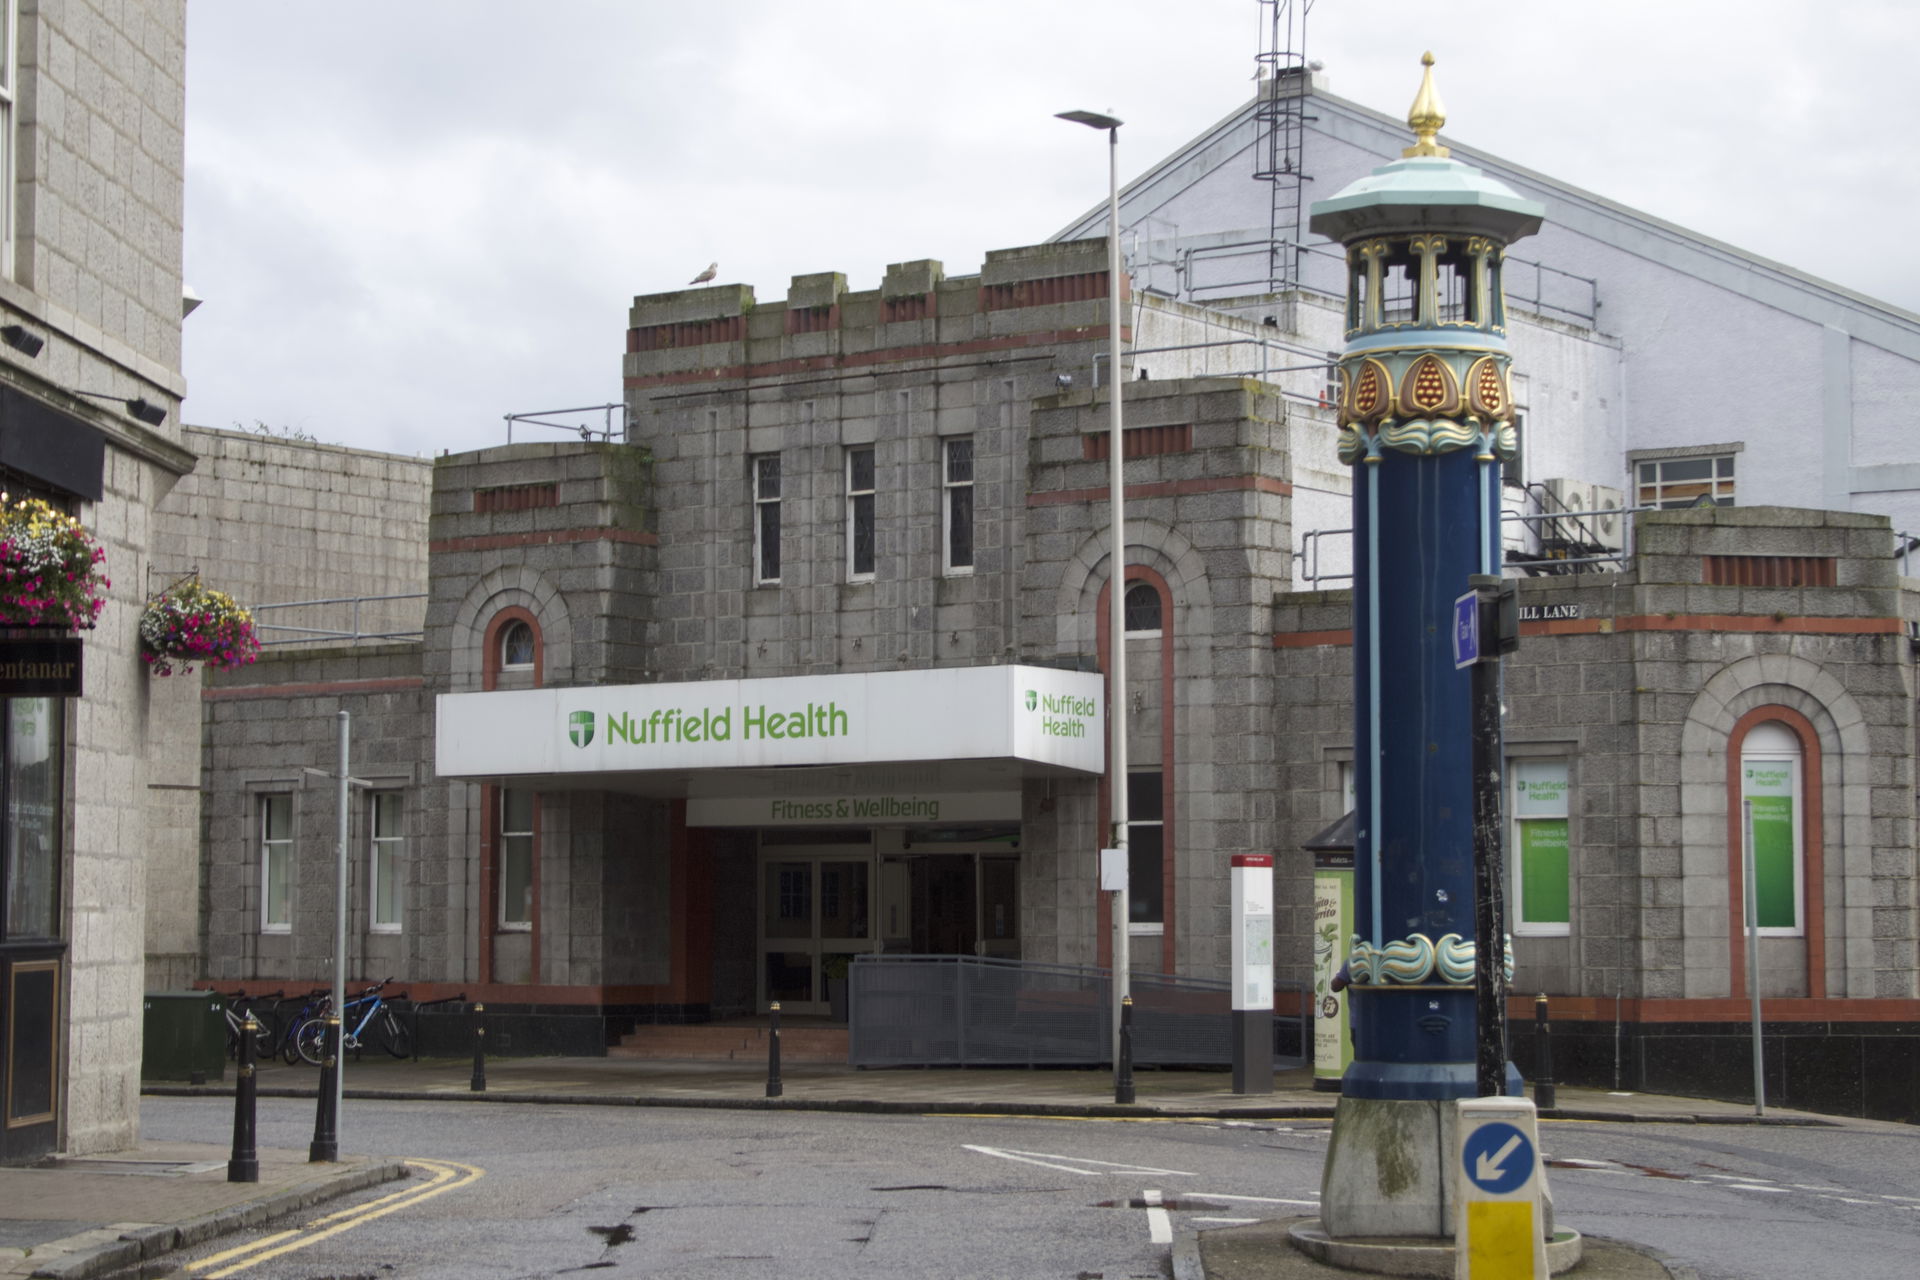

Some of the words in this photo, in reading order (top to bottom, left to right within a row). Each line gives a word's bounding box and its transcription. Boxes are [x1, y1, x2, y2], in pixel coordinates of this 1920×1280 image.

[1543, 605, 1578, 618] LANE
[1042, 693, 1095, 717] Nuffield
[607, 705, 731, 745] Nuffield
[743, 701, 848, 740] Health
[1042, 715, 1085, 738] Health
[1528, 781, 1566, 791] Nuffield
[1528, 792, 1559, 800] Health
[771, 799, 833, 820] Fitness
[835, 798, 850, 819] &
[853, 796, 940, 821] Wellbeing
